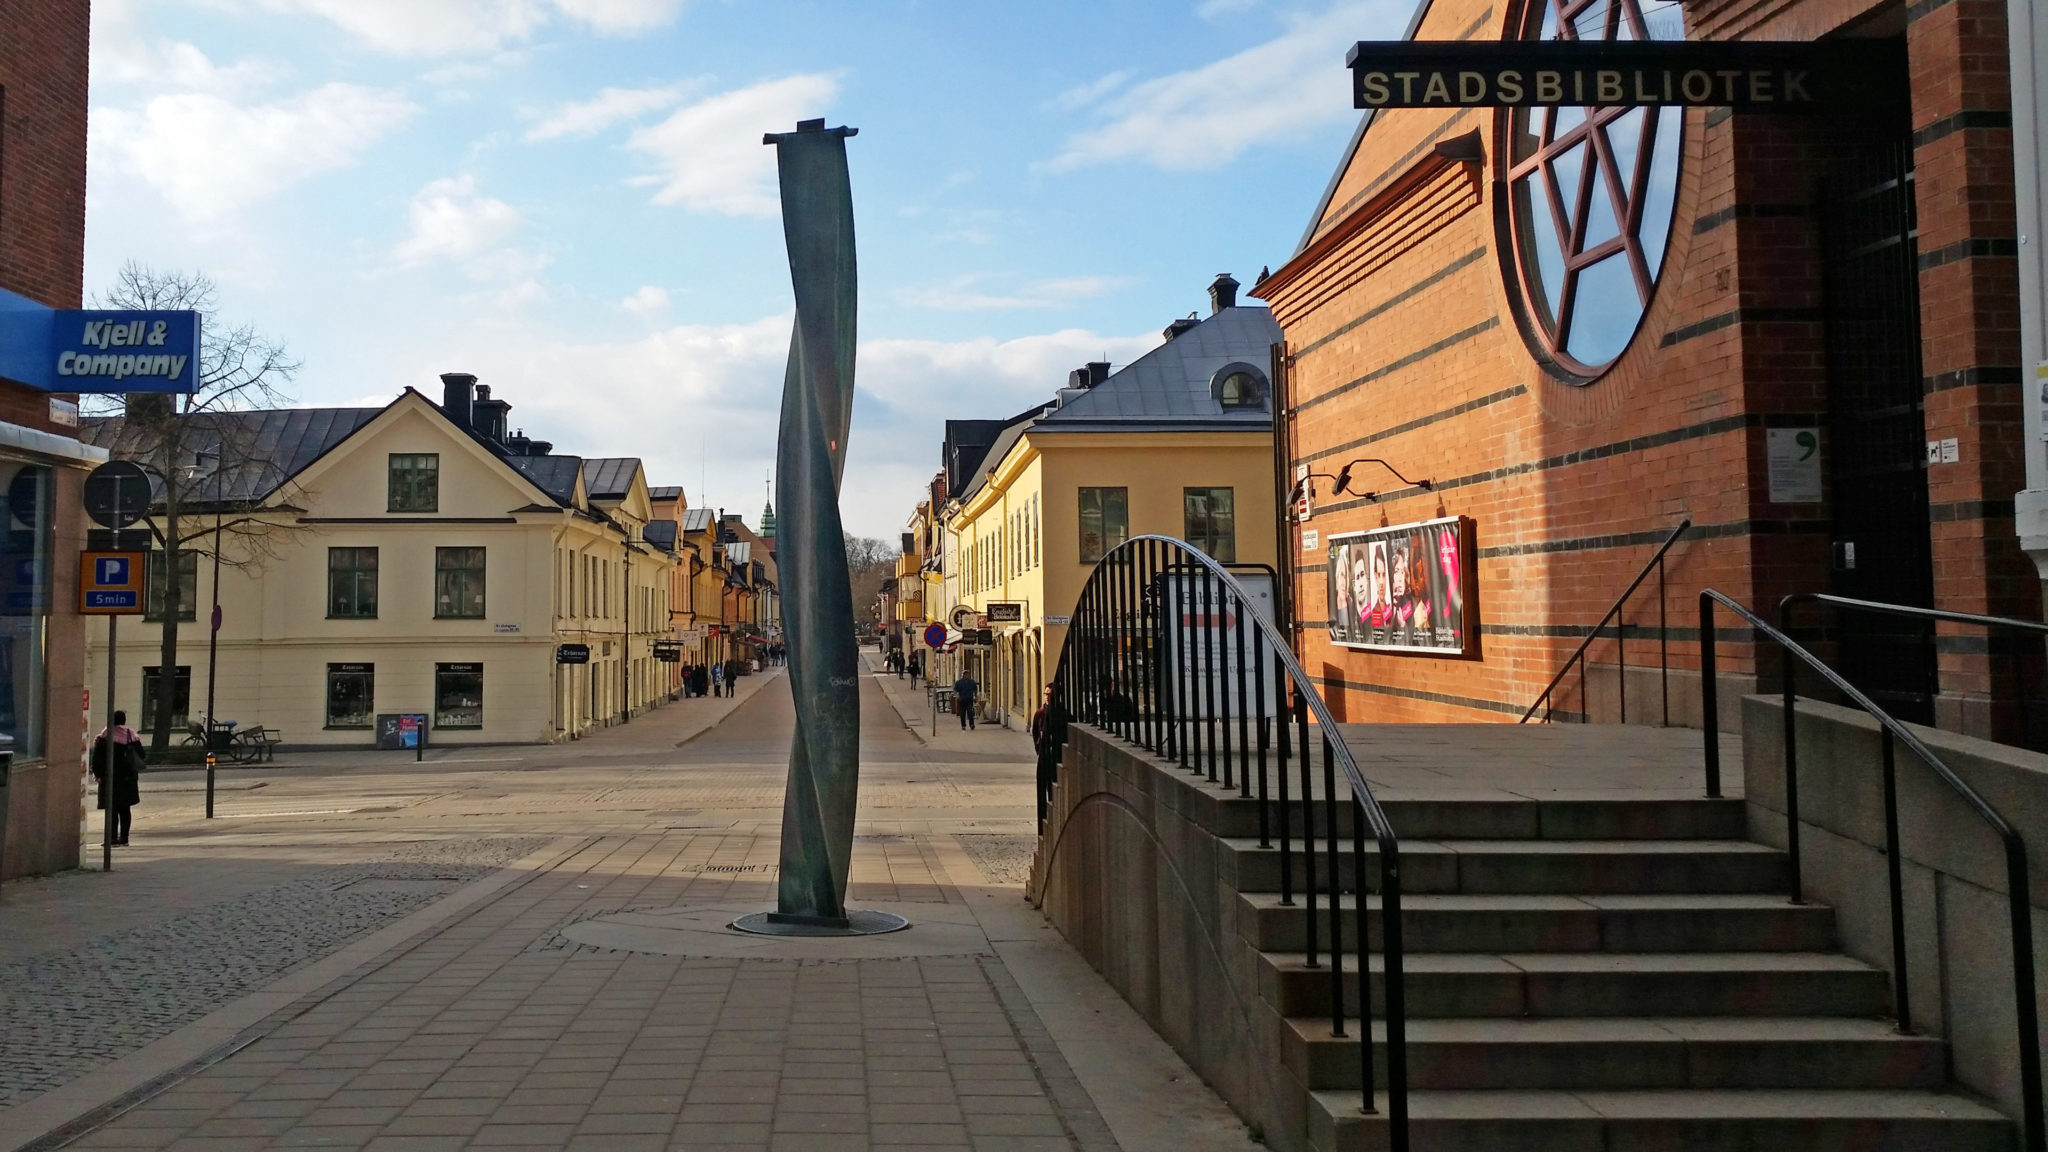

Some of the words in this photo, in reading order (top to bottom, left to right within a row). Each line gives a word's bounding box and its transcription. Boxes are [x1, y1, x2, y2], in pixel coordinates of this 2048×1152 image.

[1362, 69, 1814, 104] STADSBIBLIOTEK
[82, 319, 147, 350] Kjell
[147, 320, 168, 346] &
[57, 350, 188, 380] Company
[104, 560, 121, 583] P
[95, 594, 104, 604] 5
[104, 594, 127, 604] min
